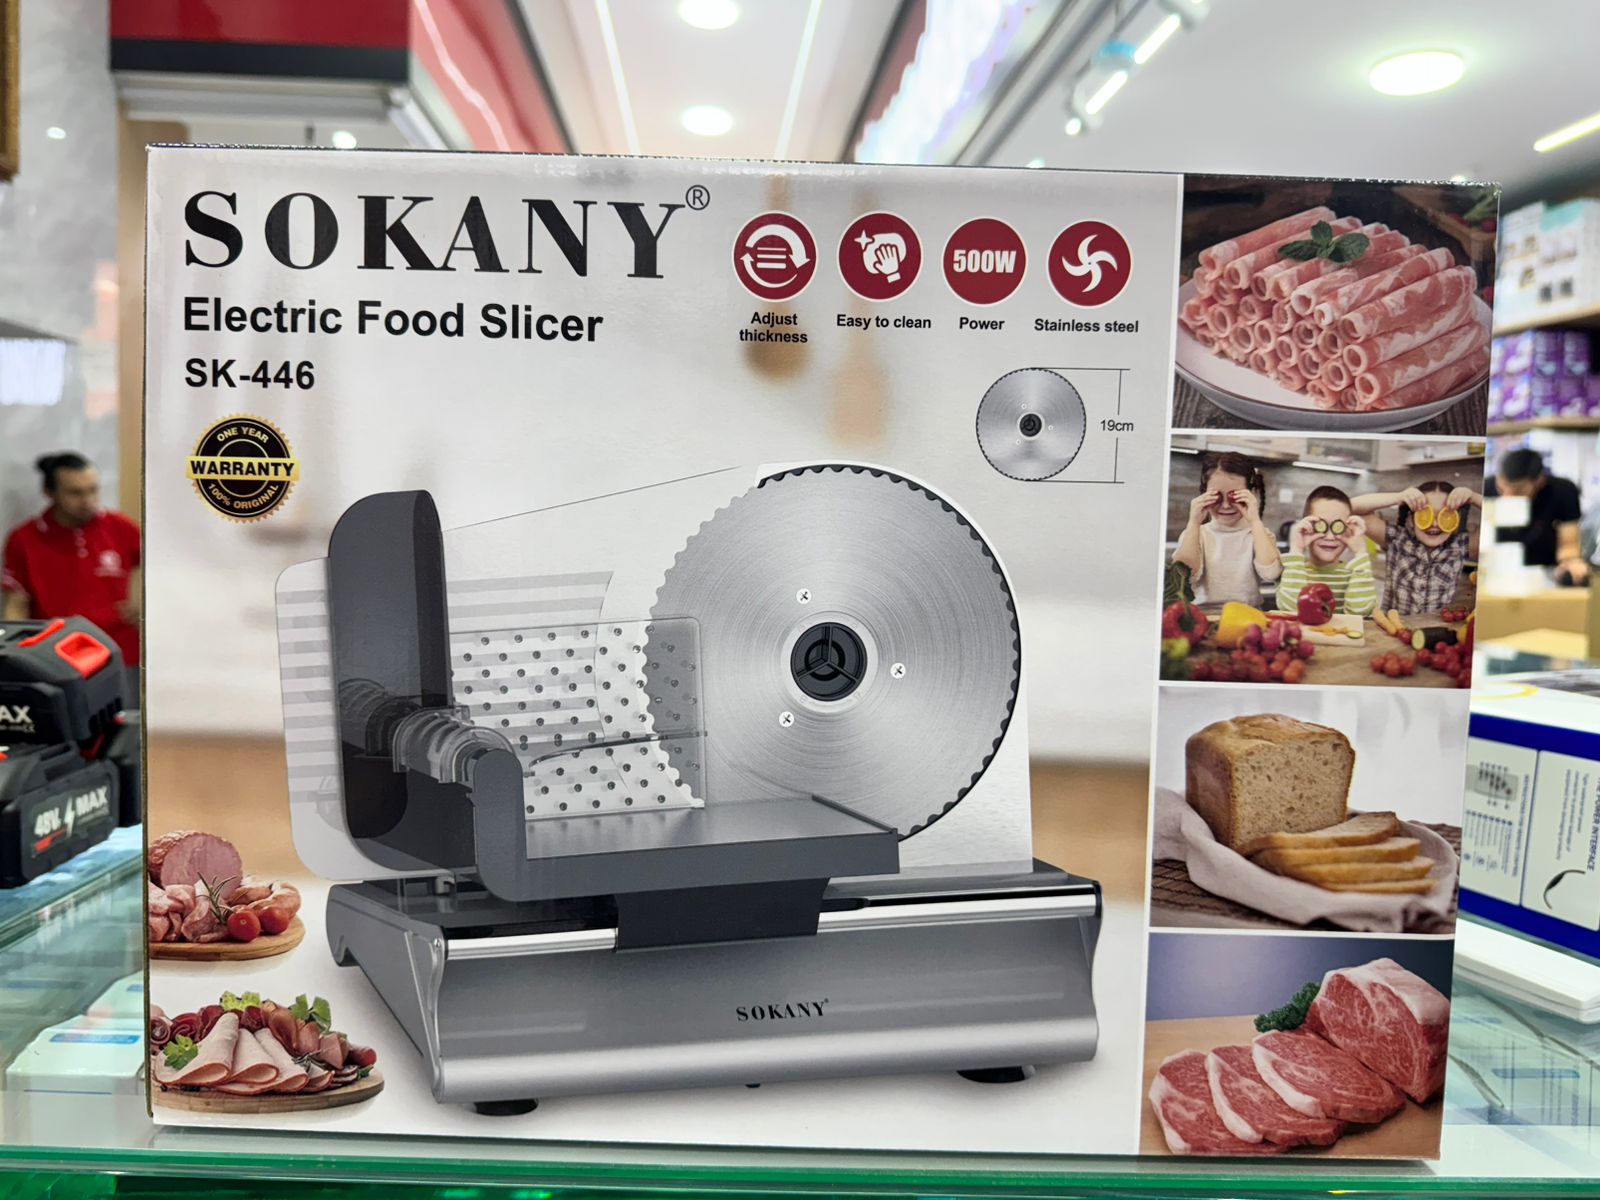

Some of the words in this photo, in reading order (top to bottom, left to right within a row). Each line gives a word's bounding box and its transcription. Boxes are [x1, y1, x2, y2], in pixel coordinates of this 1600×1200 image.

[185, 191, 685, 279] SOKANY
[953, 249, 1017, 273] 500W
[184, 296, 343, 335] Electric
[358, 300, 464, 338] Food
[480, 303, 604, 342] Slicer
[750, 311, 798, 328] Adjust
[836, 313, 871, 331] Easy
[875, 315, 890, 329] to
[893, 316, 932, 330] clean
[959, 316, 1006, 331] Power
[1034, 318, 1101, 333] Stainless
[1104, 319, 1139, 334] steel
[739, 328, 808, 344] thickness
[184, 358, 315, 390] SK-446
[216, 427, 239, 442] ONE
[241, 427, 269, 443] YEAR
[1100, 419, 1134, 433] 19cm
[190, 460, 294, 476] WARRANTY
[208, 483, 231, 506] 100%
[233, 484, 279, 510] ORIGINAL
[0, 704, 32, 724] AX
[76, 785, 108, 817] MAX
[736, 1002, 824, 1022] SOKANY
